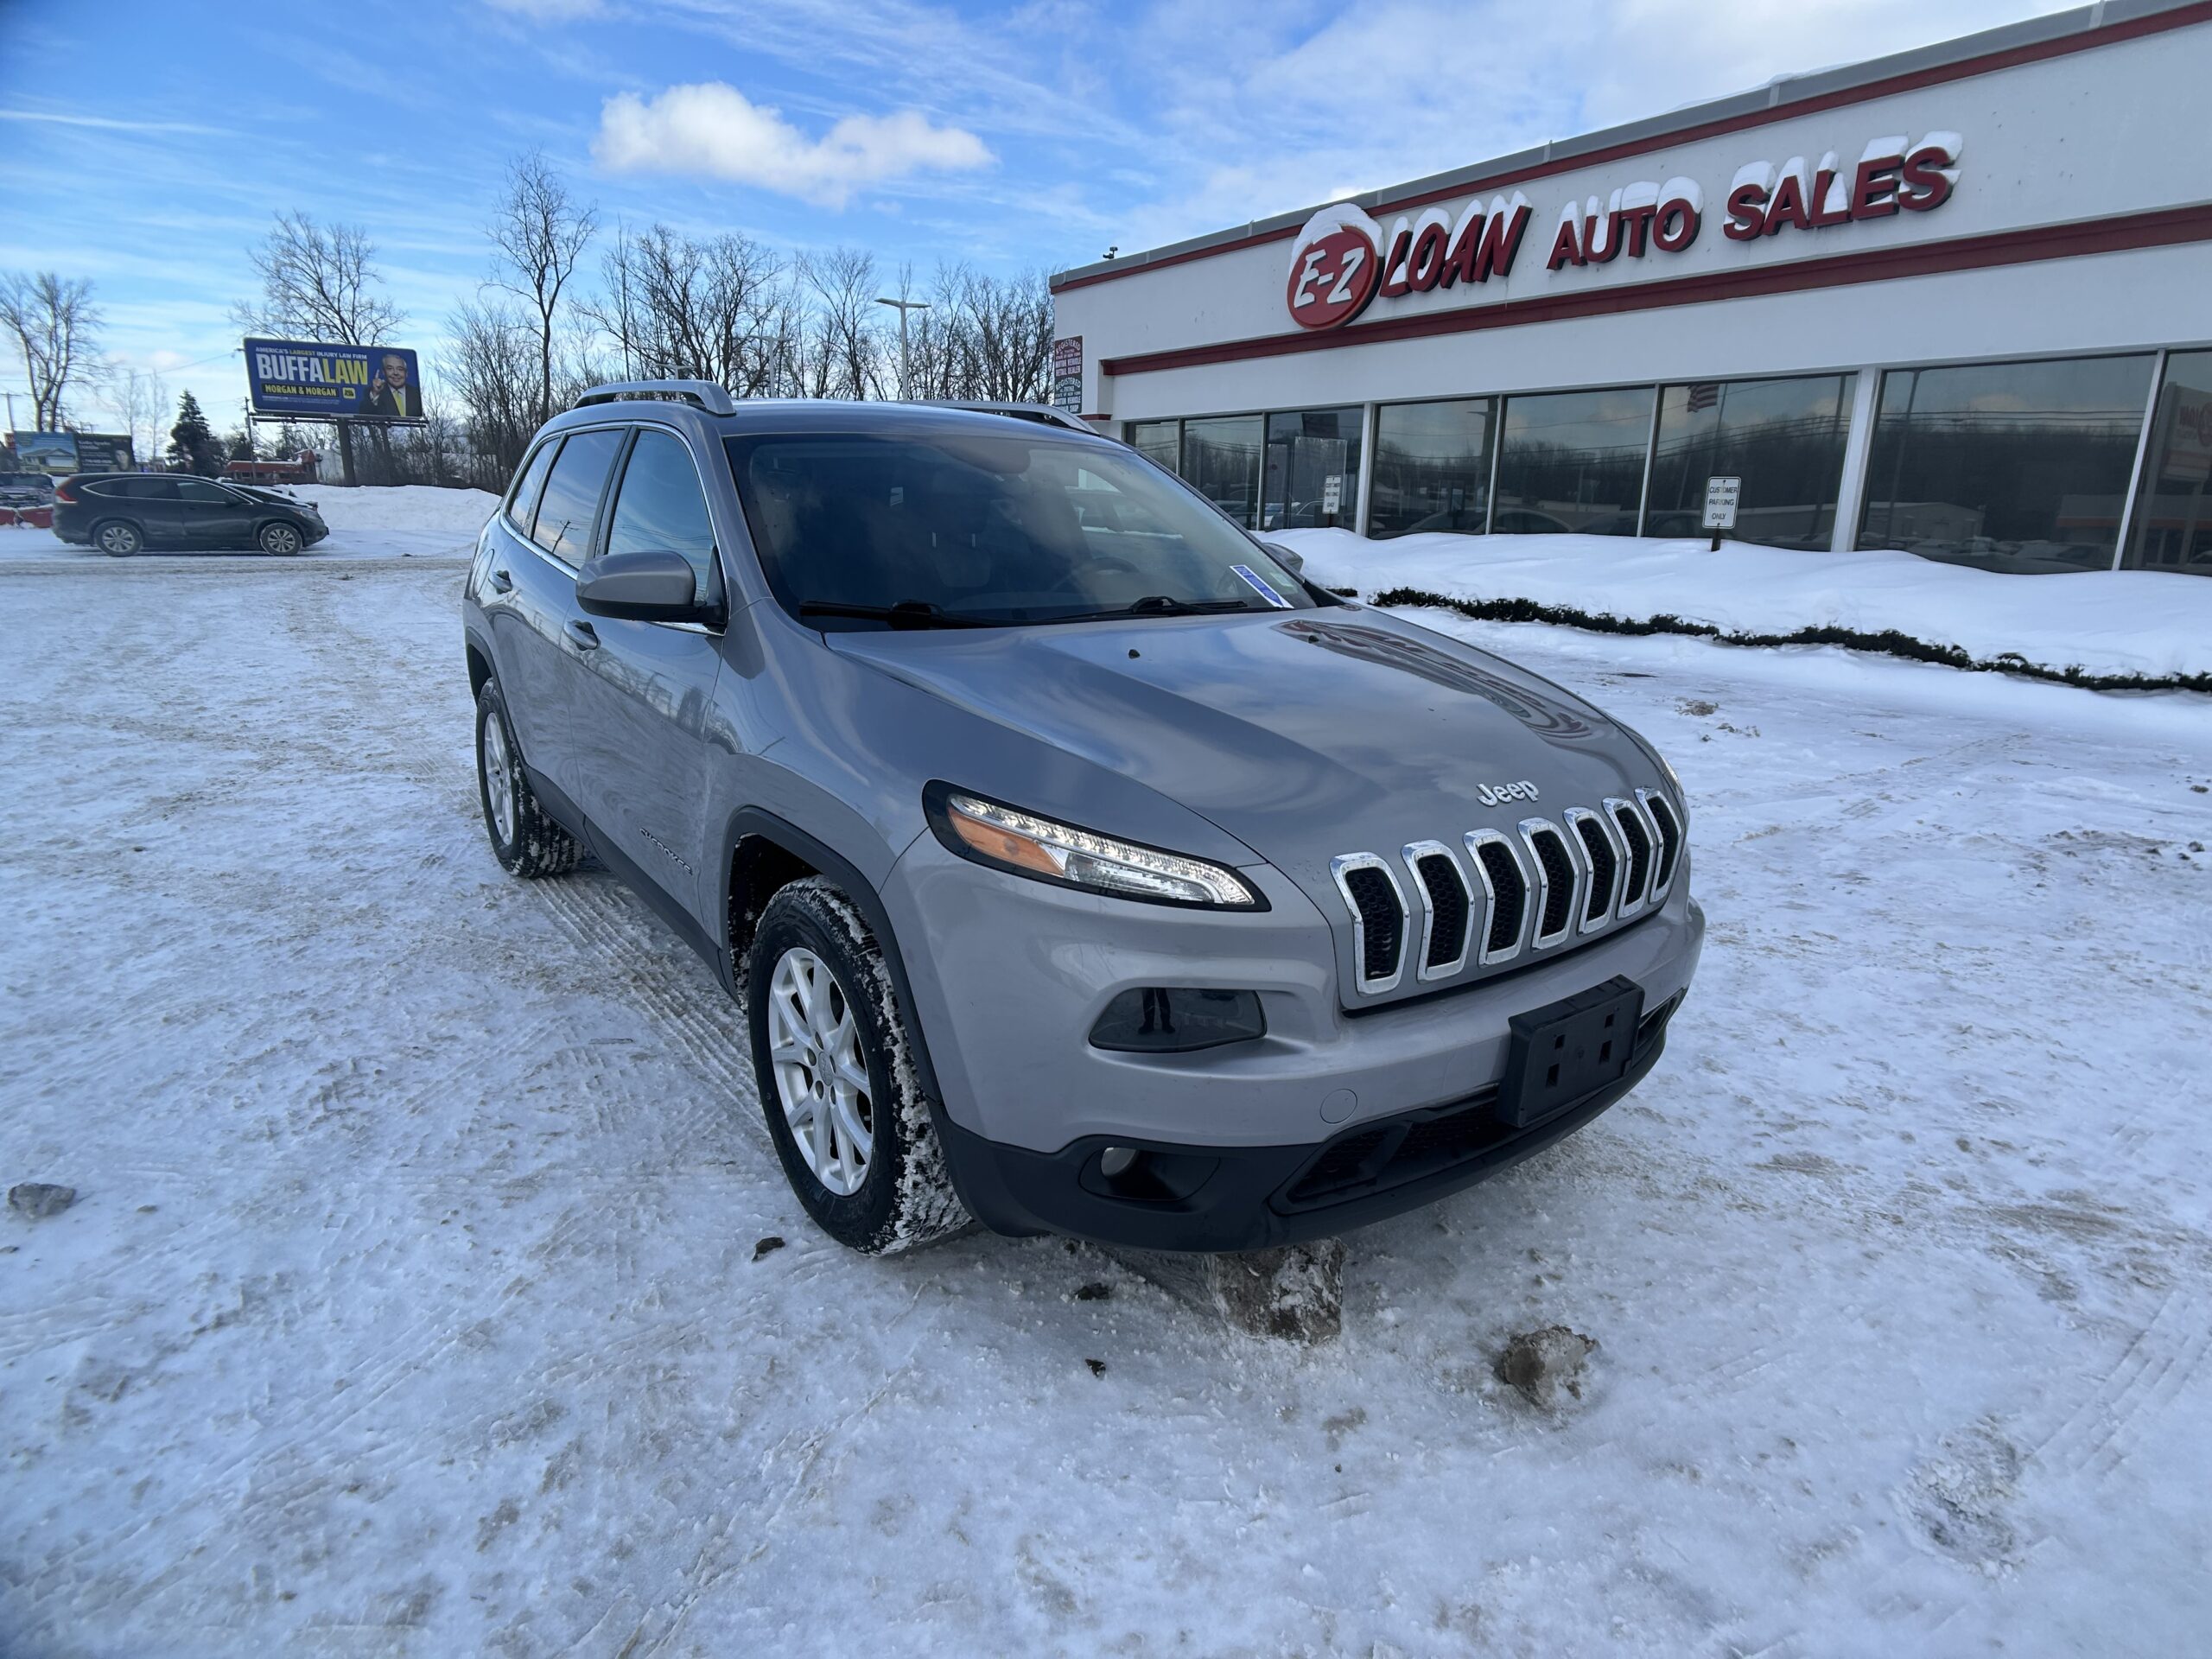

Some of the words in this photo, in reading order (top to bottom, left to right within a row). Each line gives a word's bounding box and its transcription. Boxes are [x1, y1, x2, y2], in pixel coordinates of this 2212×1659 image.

[1294, 247, 1365, 308] E-Z
[1380, 205, 1532, 297] LOAN
[1547, 204, 1701, 270] AUTO
[1724, 144, 1955, 240] SALES
[1056, 339, 1081, 354] REGISTERED
[256, 353, 368, 385] BUFFALAW
[264, 385, 296, 395] MORGAN
[305, 387, 337, 397] MORGAN
[1056, 377, 1081, 391] REGISTERED
[1476, 780, 1539, 807] Jeep
